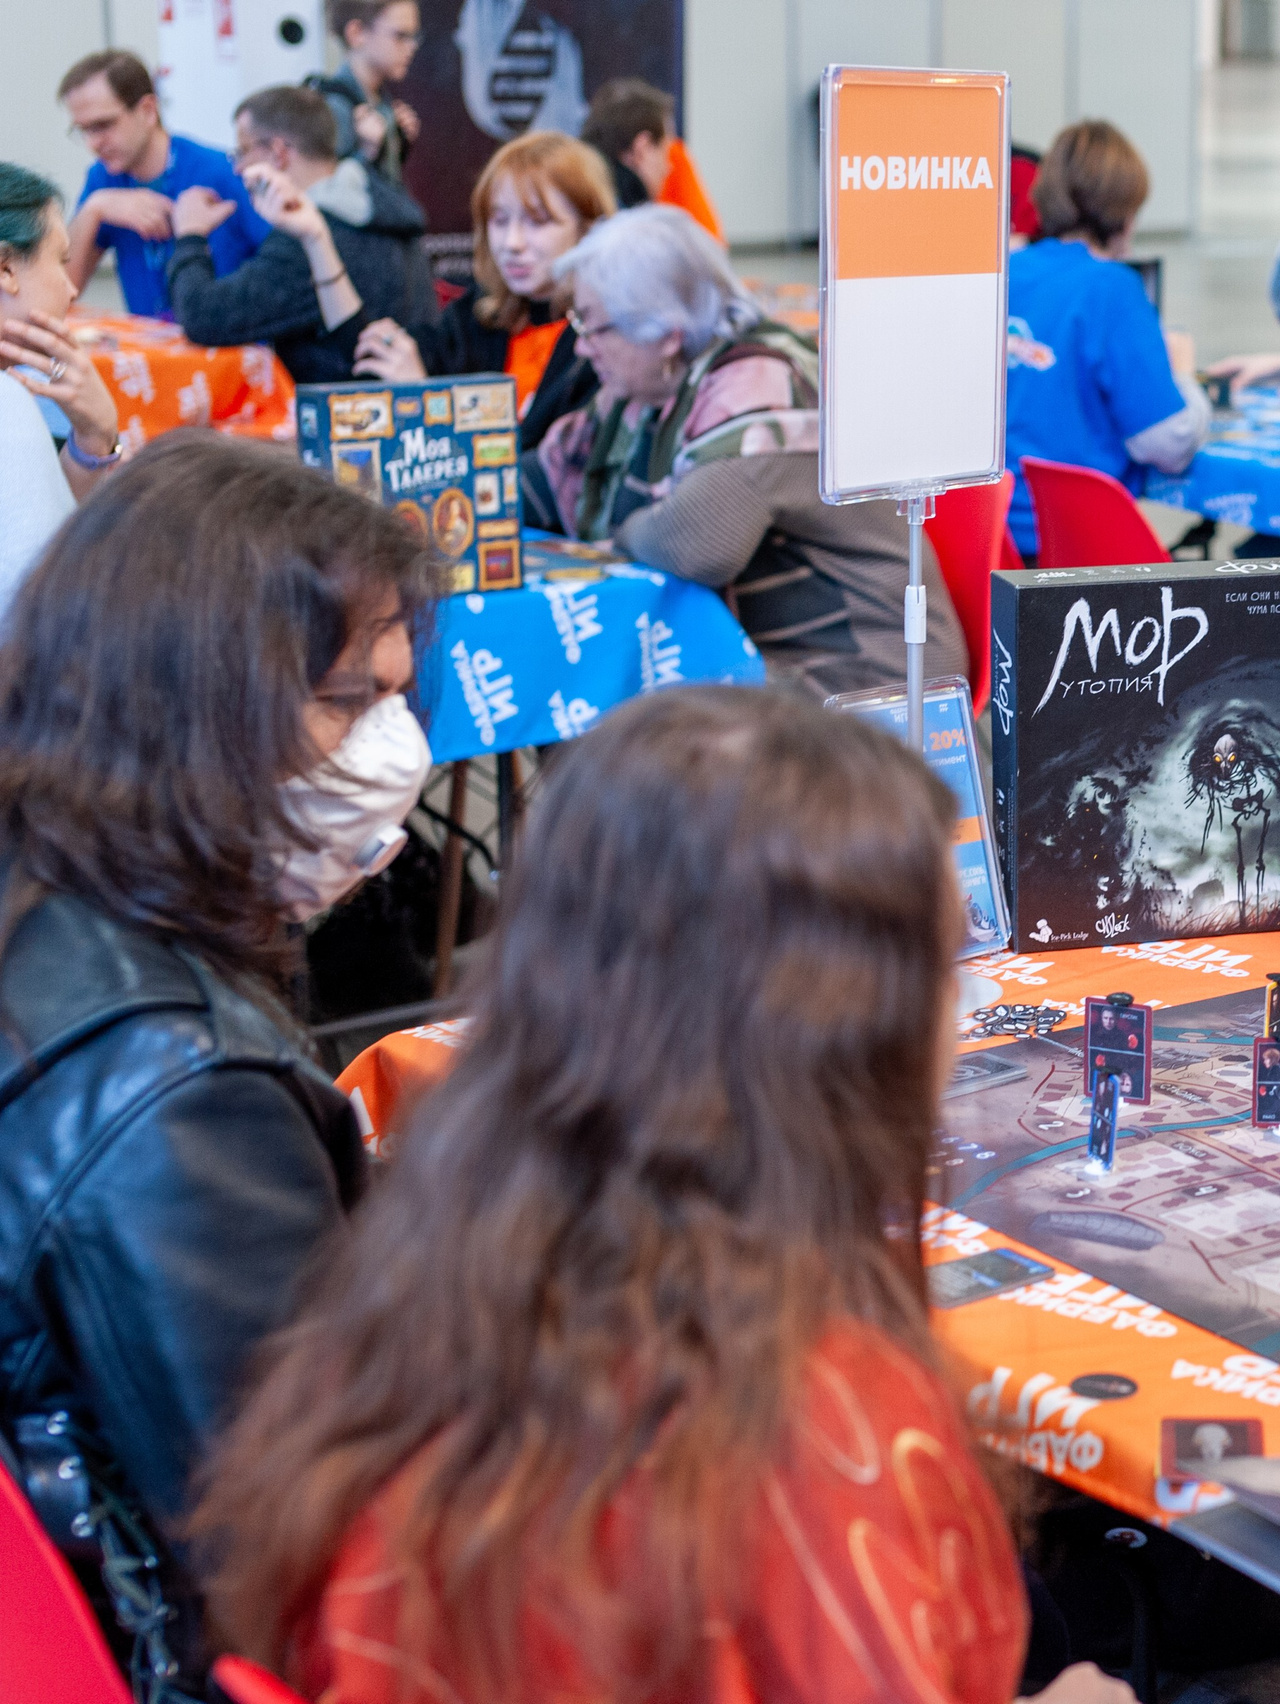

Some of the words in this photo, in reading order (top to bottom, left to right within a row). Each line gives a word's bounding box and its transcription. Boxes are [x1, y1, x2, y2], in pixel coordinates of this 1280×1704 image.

[840, 154, 994, 191] НОВИНКА
[1225, 592, 1248, 603] ЕСЛИ
[1250, 591, 1271, 602] ОНИ
[1247, 604, 1267, 615] ЧУМА
[1060, 675, 1153, 699] УТОПИЯ
[930, 728, 967, 751] 20%
[1101, 945, 1251, 978] ФАБРИКА
[1137, 941, 1254, 968] ИГР
[957, 965, 1049, 985] ФАБР
[1038, 1120, 1065, 1130] 2
[1066, 1188, 1091, 1198] 3
[1194, 1185, 1218, 1196] 4
